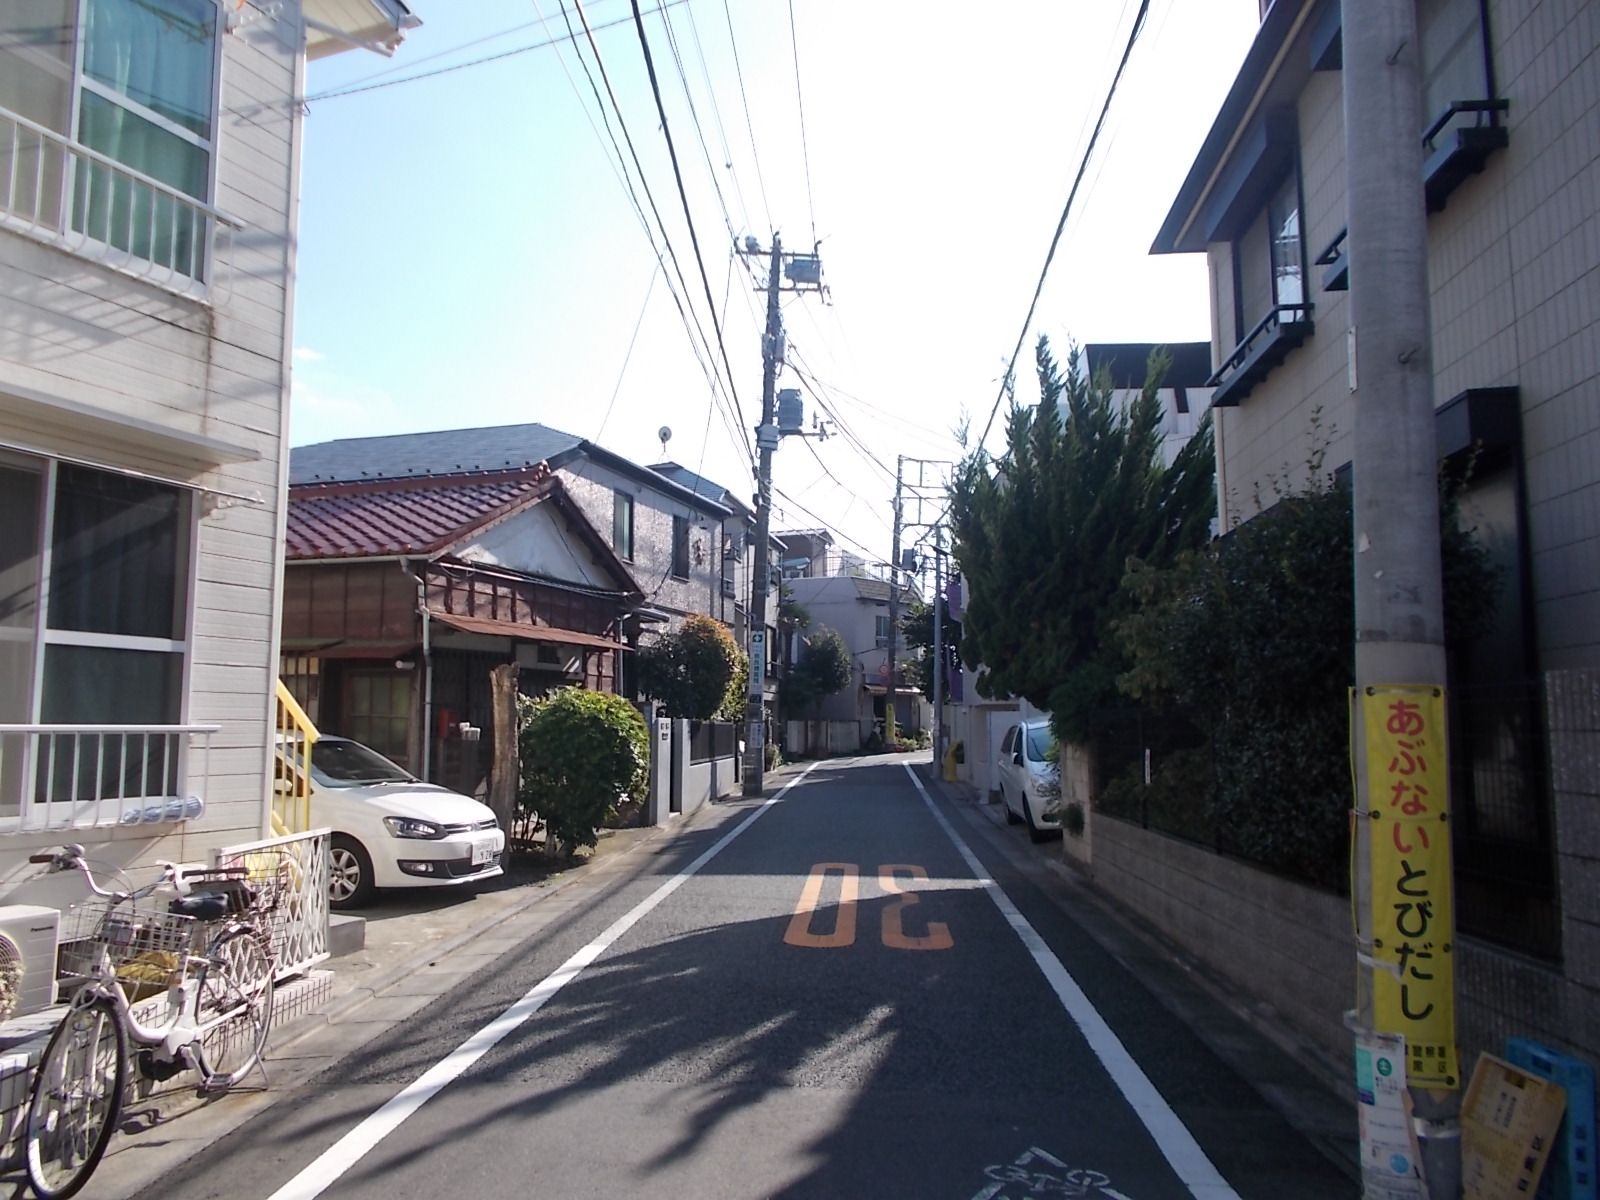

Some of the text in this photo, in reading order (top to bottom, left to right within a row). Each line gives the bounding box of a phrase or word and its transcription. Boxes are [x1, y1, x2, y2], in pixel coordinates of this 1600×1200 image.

[783, 862, 955, 950] 30
[1387, 700, 1434, 1021] あぶないとびだし
